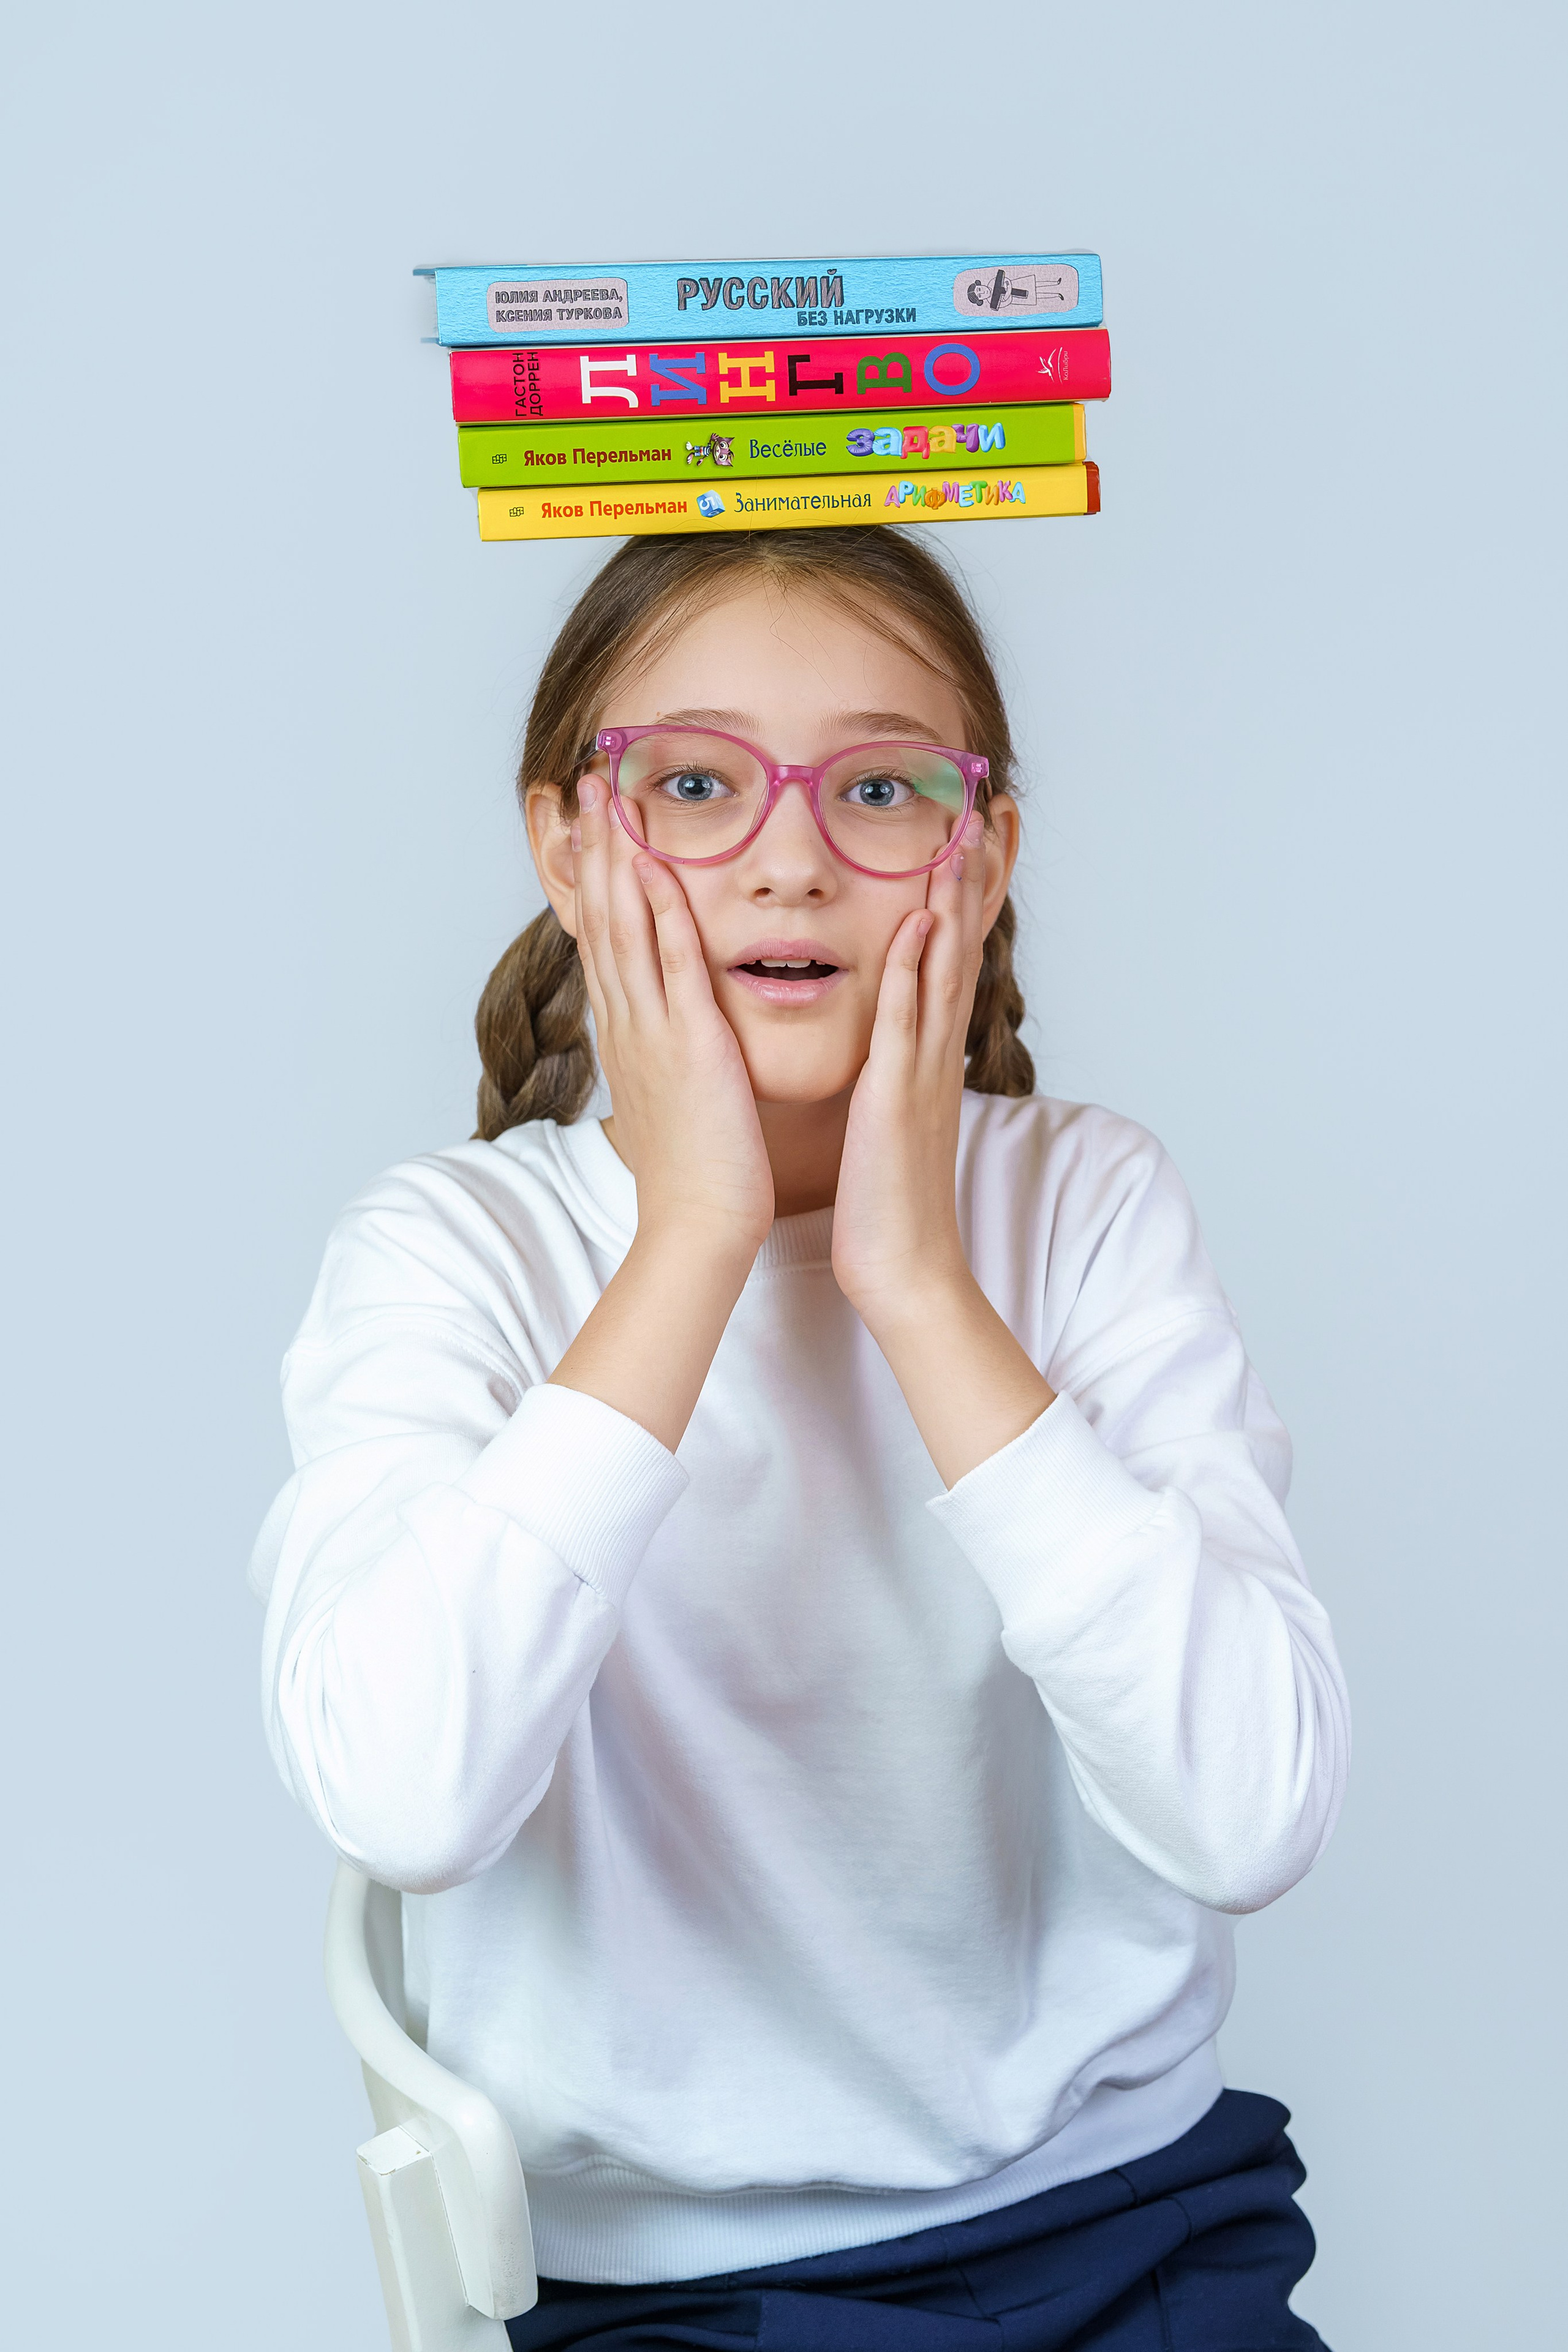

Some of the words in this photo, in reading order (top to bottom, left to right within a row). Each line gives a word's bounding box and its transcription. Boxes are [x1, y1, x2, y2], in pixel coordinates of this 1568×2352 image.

[496, 290, 538, 304] ЮЛИЯ
[543, 288, 623, 303] АНДРЕЕВА,
[677, 268, 845, 311] РУССКИЙ
[496, 309, 552, 323] КСЕНИЯ
[557, 307, 622, 320] ТУРКОВА
[797, 311, 827, 326] БЕЗ
[834, 307, 917, 325] НАГРУЗКИ
[513, 352, 527, 417] ГАСТОН
[527, 352, 543, 417] ДОРРЕН
[580, 342, 981, 409] ЛИНГВО
[524, 450, 567, 466] Яков
[573, 447, 672, 468] Перельман
[749, 439, 827, 459] Весёлые
[541, 502, 584, 519] Яков
[590, 499, 688, 520] Перельман
[734, 492, 872, 513] Занимательная
[884, 480, 1026, 510] АРИФМЕТИКА
